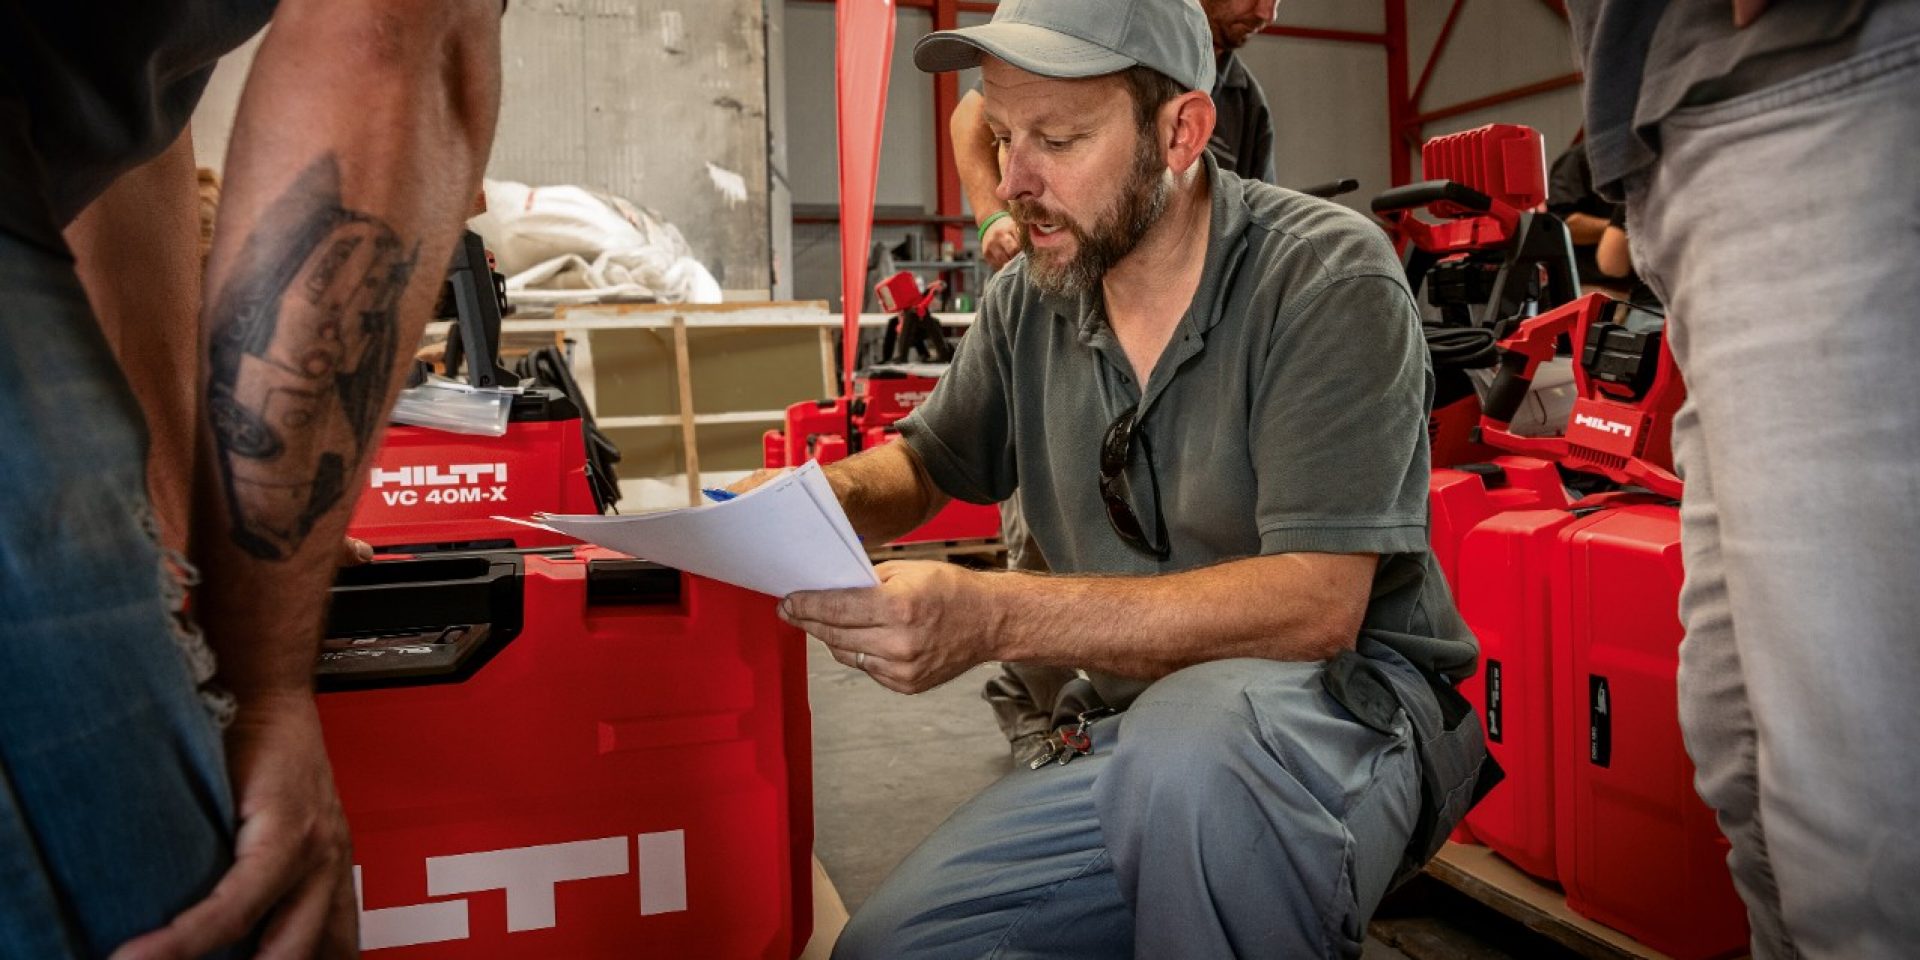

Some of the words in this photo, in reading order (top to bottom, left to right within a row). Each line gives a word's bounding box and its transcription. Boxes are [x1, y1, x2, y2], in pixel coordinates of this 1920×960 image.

[1575, 413, 1632, 437] HILTI
[370, 463, 507, 488] HILTI
[382, 490, 418, 506] VC
[425, 486, 507, 504] 40M-X
[352, 828, 687, 951] LTI
